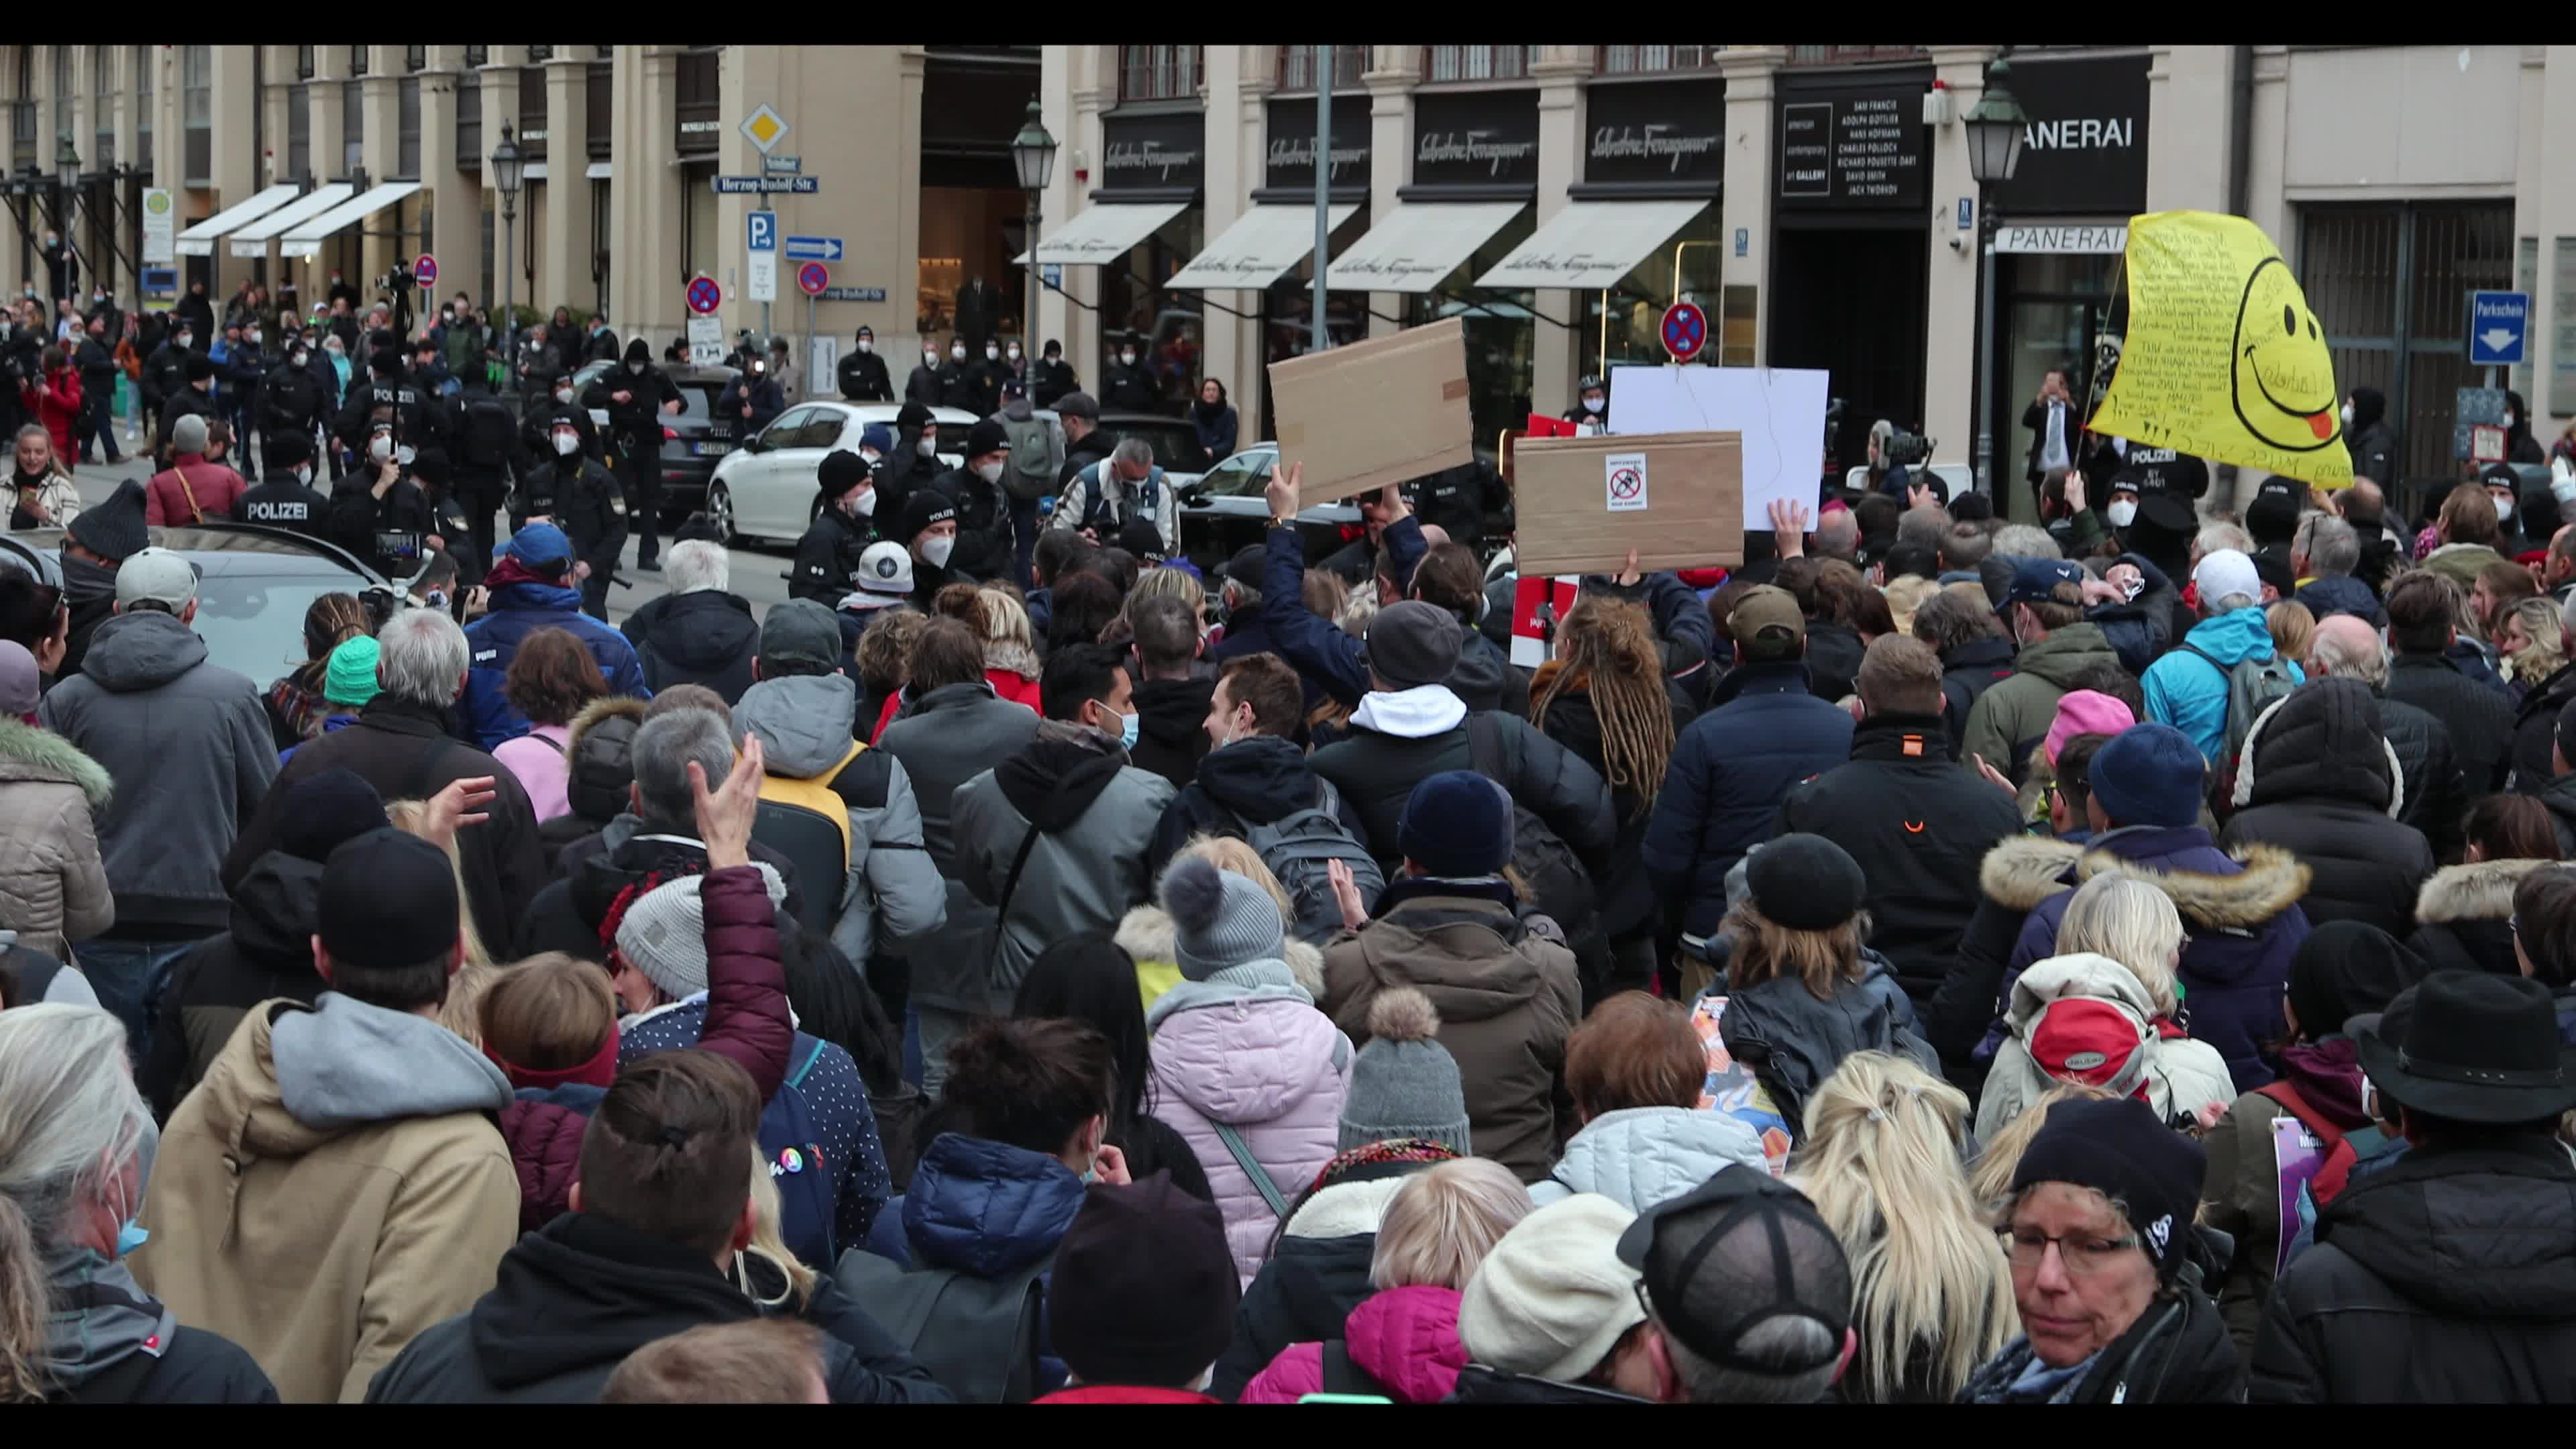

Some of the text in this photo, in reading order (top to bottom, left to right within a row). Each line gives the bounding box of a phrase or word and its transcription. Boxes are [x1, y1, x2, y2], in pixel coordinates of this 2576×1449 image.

[2023, 117, 2132, 150] ANERAI
[1796, 169, 1826, 180] GALLERY
[722, 178, 814, 193] Herzog-Rudolf-Str.
[752, 216, 768, 247] P
[2009, 227, 2121, 250] PANERAI
[2477, 302, 2524, 317] Parkschein
[374, 388, 415, 404] POLZEI
[2131, 448, 2176, 466] POLIZEI
[248, 502, 308, 521] POLIZEI
[475, 649, 496, 662] PUMA
